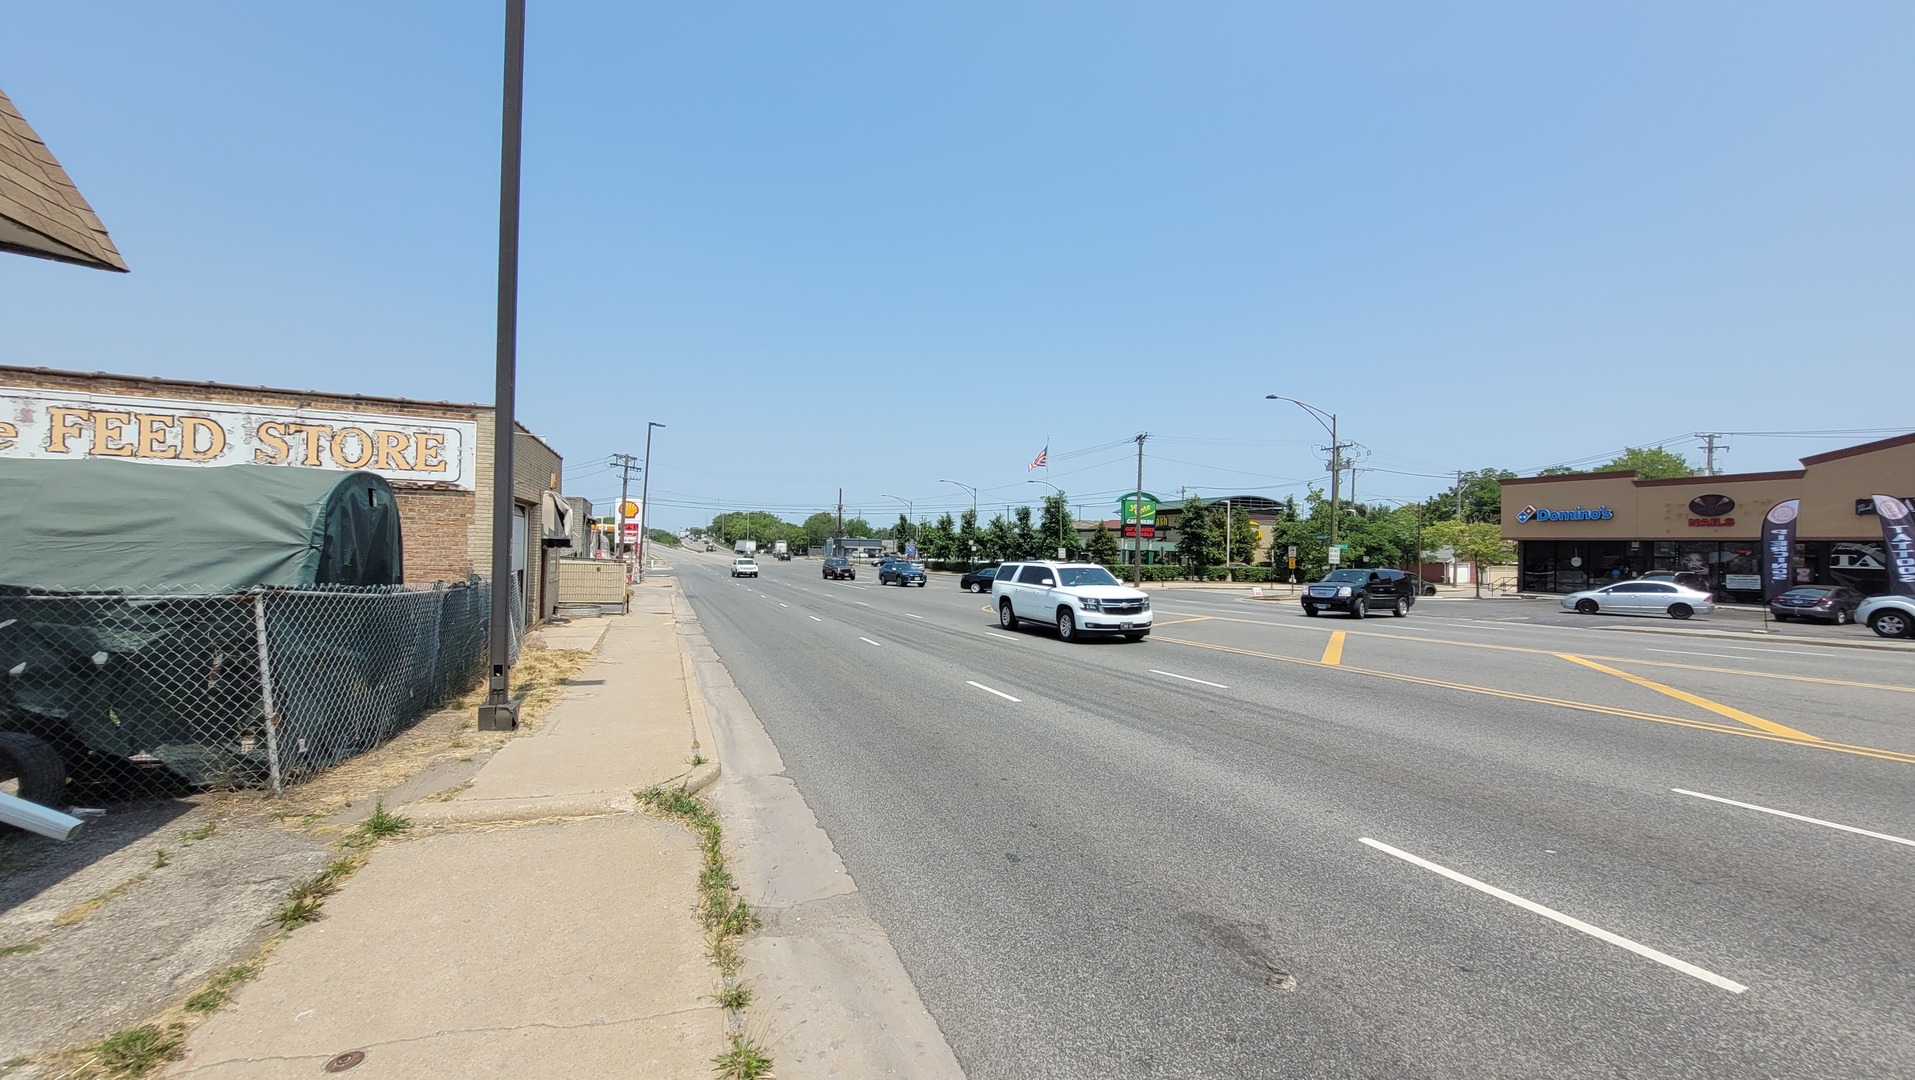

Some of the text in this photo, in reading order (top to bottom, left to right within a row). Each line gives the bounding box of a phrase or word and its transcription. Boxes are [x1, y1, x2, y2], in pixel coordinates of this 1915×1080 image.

[46, 406, 227, 460] FEED
[254, 419, 448, 472] STORE
[1536, 505, 1613, 521] Domino's
[1688, 517, 1735, 527] NAILS
[1887, 525, 1915, 583] TATTOOS
